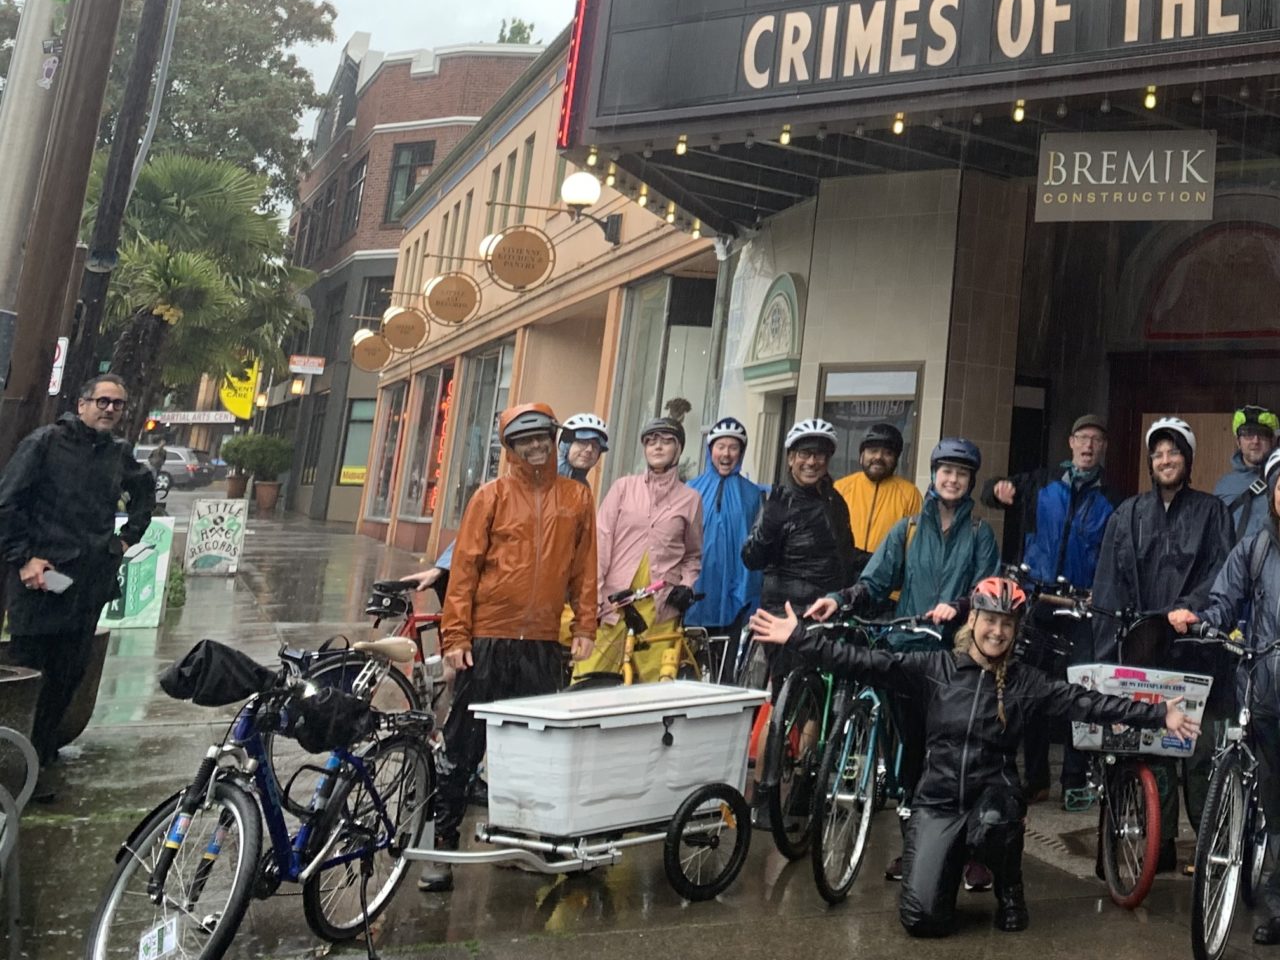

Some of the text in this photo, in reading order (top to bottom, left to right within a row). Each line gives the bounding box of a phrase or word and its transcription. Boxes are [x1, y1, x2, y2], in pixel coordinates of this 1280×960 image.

[1043, 149, 1209, 186] BREMIK
[1043, 191, 1207, 204] CONSTRUCTION
[191, 412, 210, 422] ARTS
[196, 503, 243, 520] LITTLE
[189, 540, 239, 559] RECORDS
